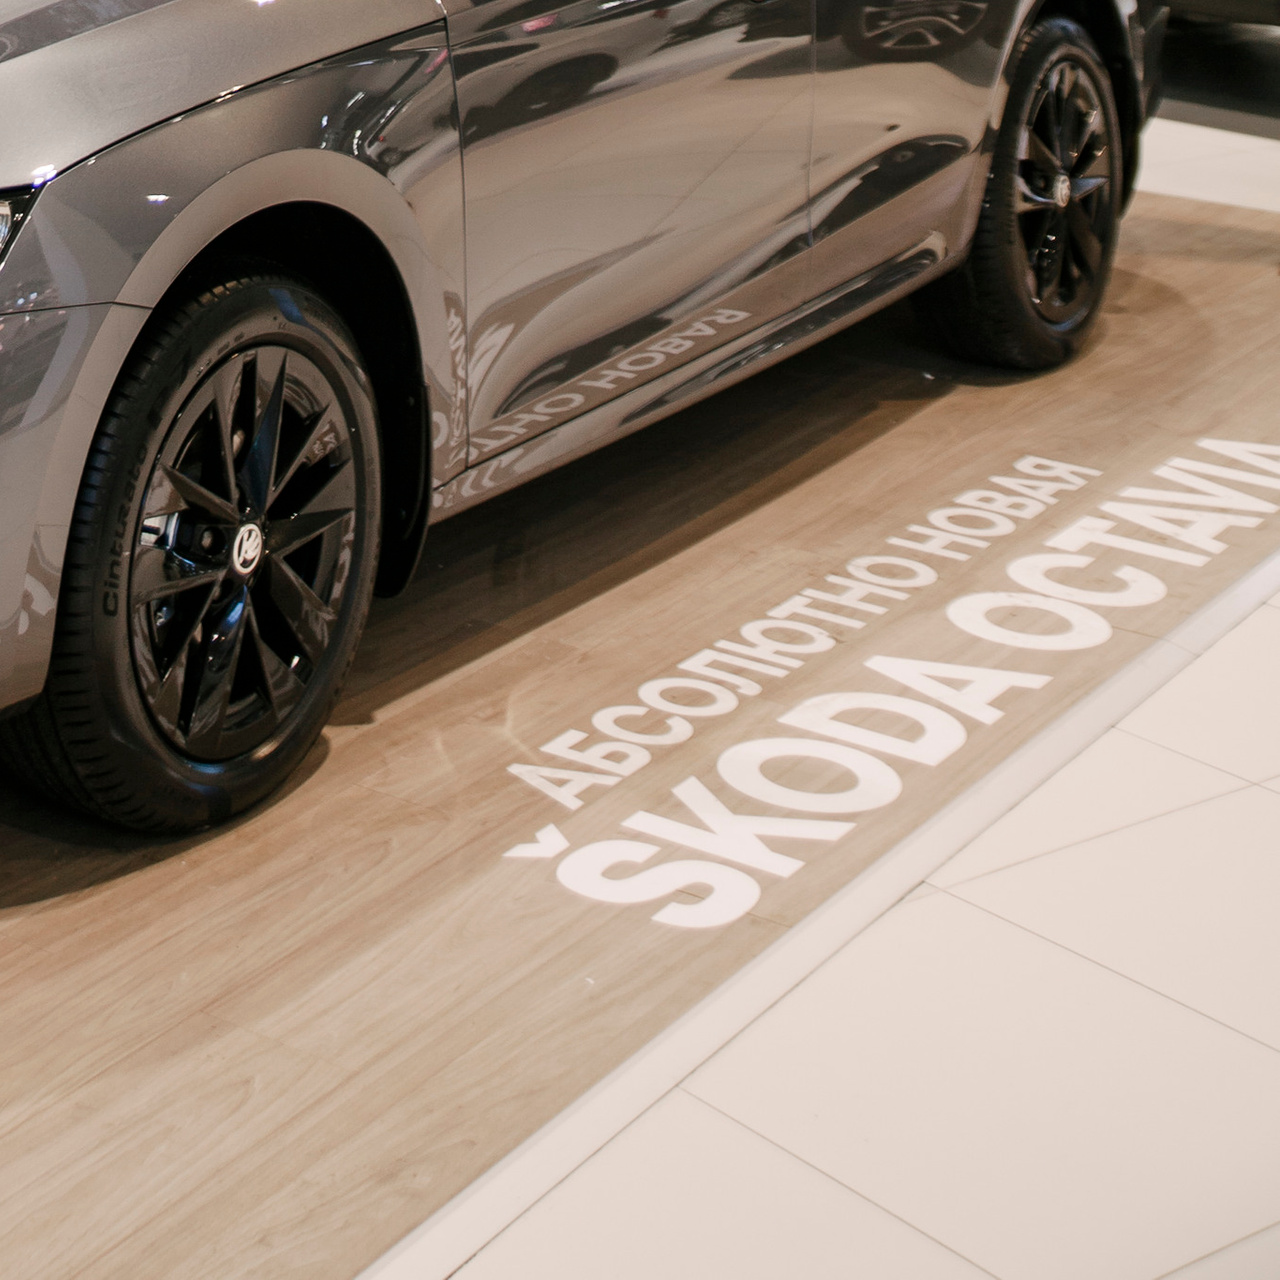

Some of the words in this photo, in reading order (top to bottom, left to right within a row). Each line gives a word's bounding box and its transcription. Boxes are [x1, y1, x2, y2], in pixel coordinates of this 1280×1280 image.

[506, 554, 938, 811] АБСОЛЮТНО
[886, 454, 1105, 564] НОВАЯ
[502, 653, 1054, 929] ŠKODA
